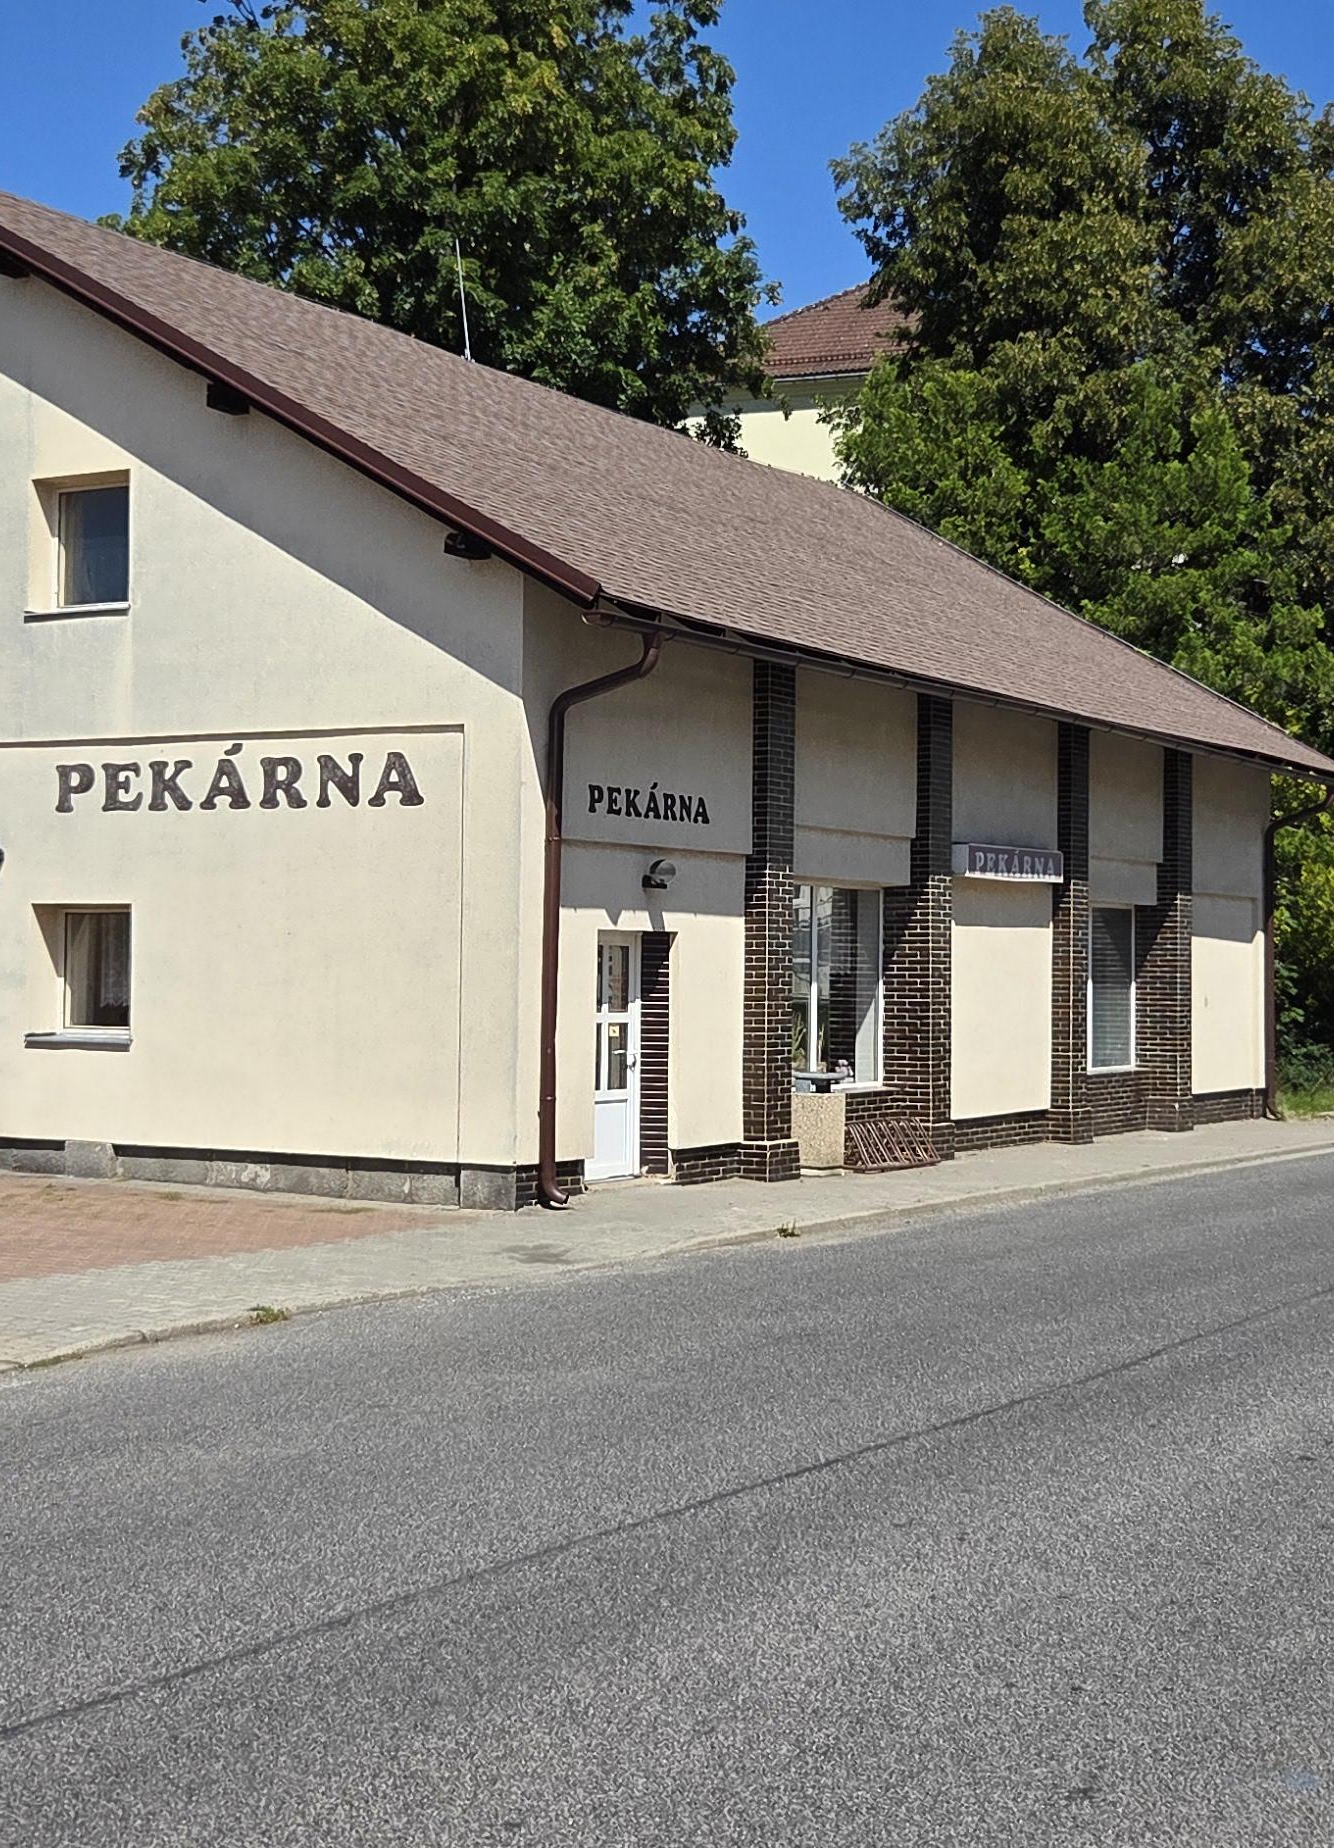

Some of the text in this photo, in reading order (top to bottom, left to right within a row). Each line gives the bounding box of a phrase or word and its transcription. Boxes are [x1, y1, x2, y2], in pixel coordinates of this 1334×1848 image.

[55, 742, 425, 814] PEKÁRNA
[587, 781, 710, 825] PEKÁRNA
[974, 849, 1056, 879] PEKÁRNA
